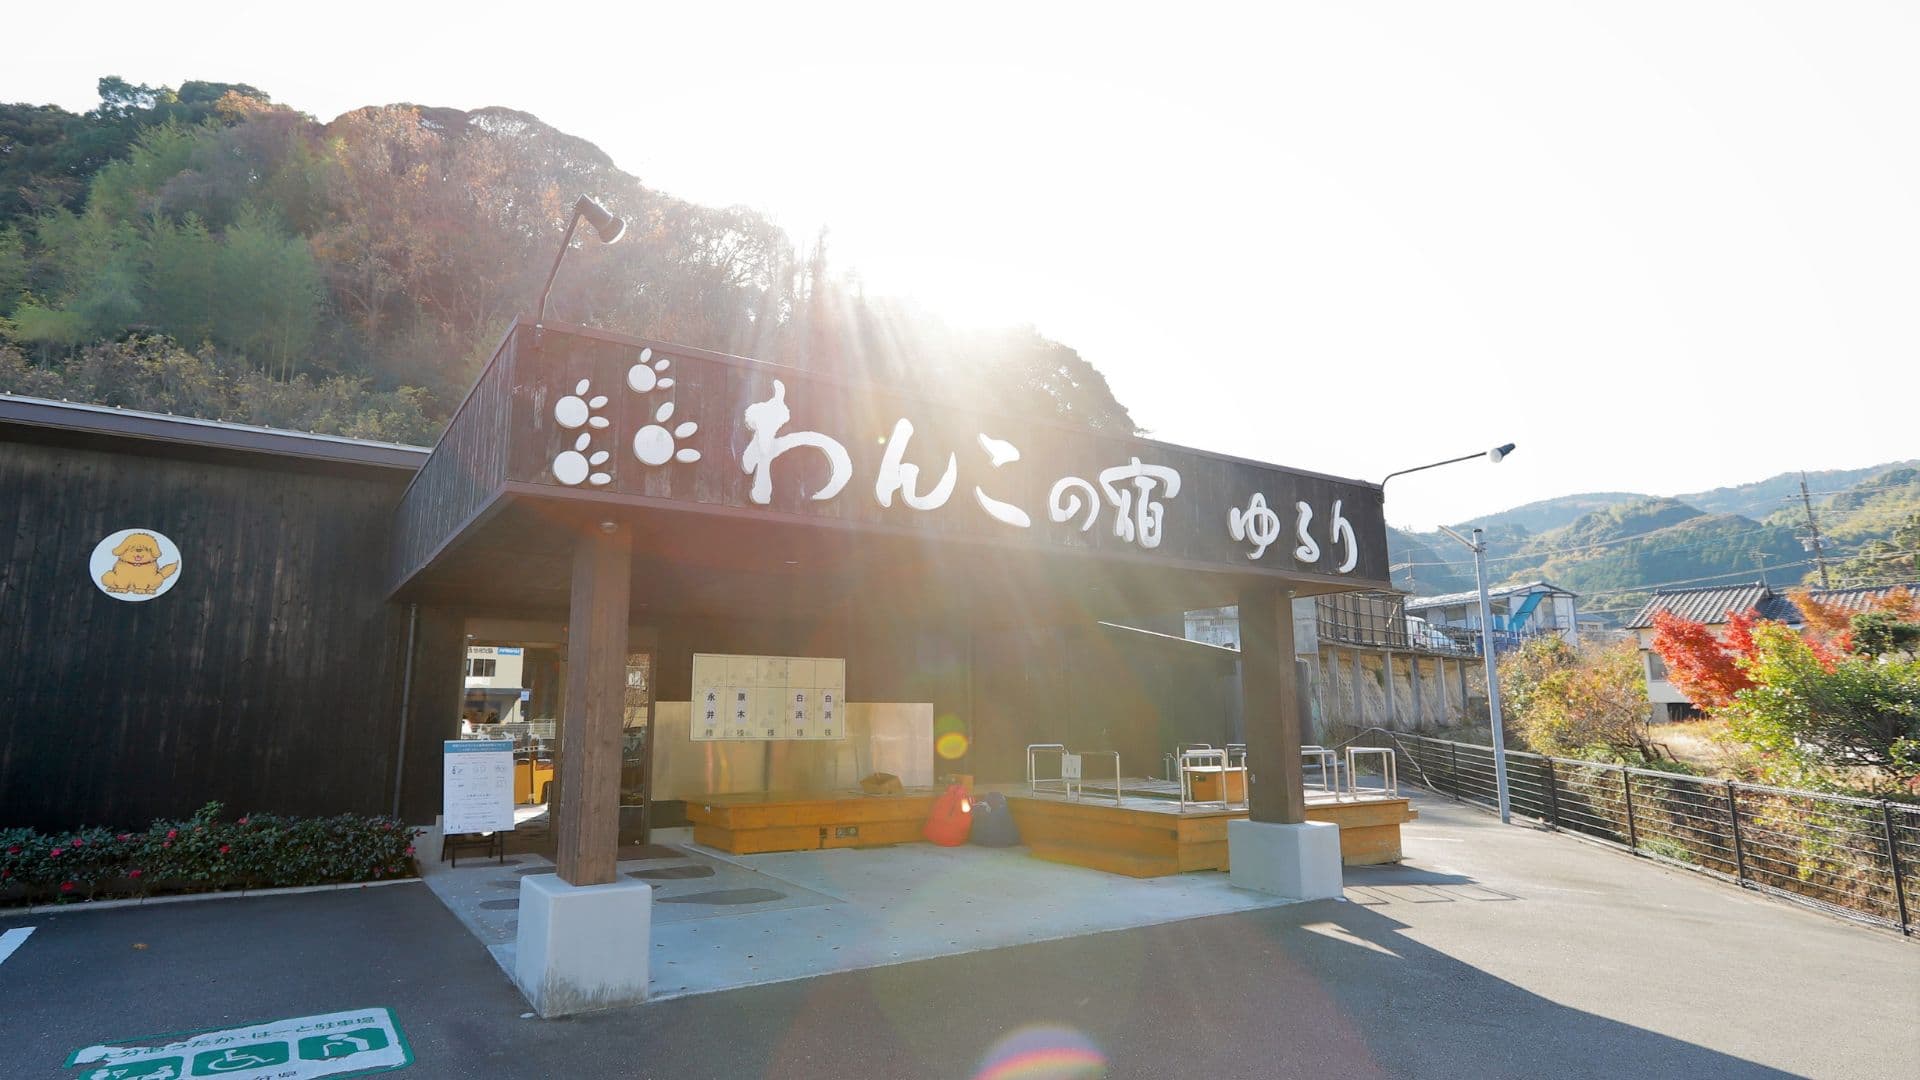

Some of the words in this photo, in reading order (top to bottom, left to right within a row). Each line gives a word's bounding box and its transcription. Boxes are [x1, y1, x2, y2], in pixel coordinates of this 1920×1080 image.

[742, 379, 1181, 549] わんこの宿
[1230, 492, 1359, 574] ゆるり
